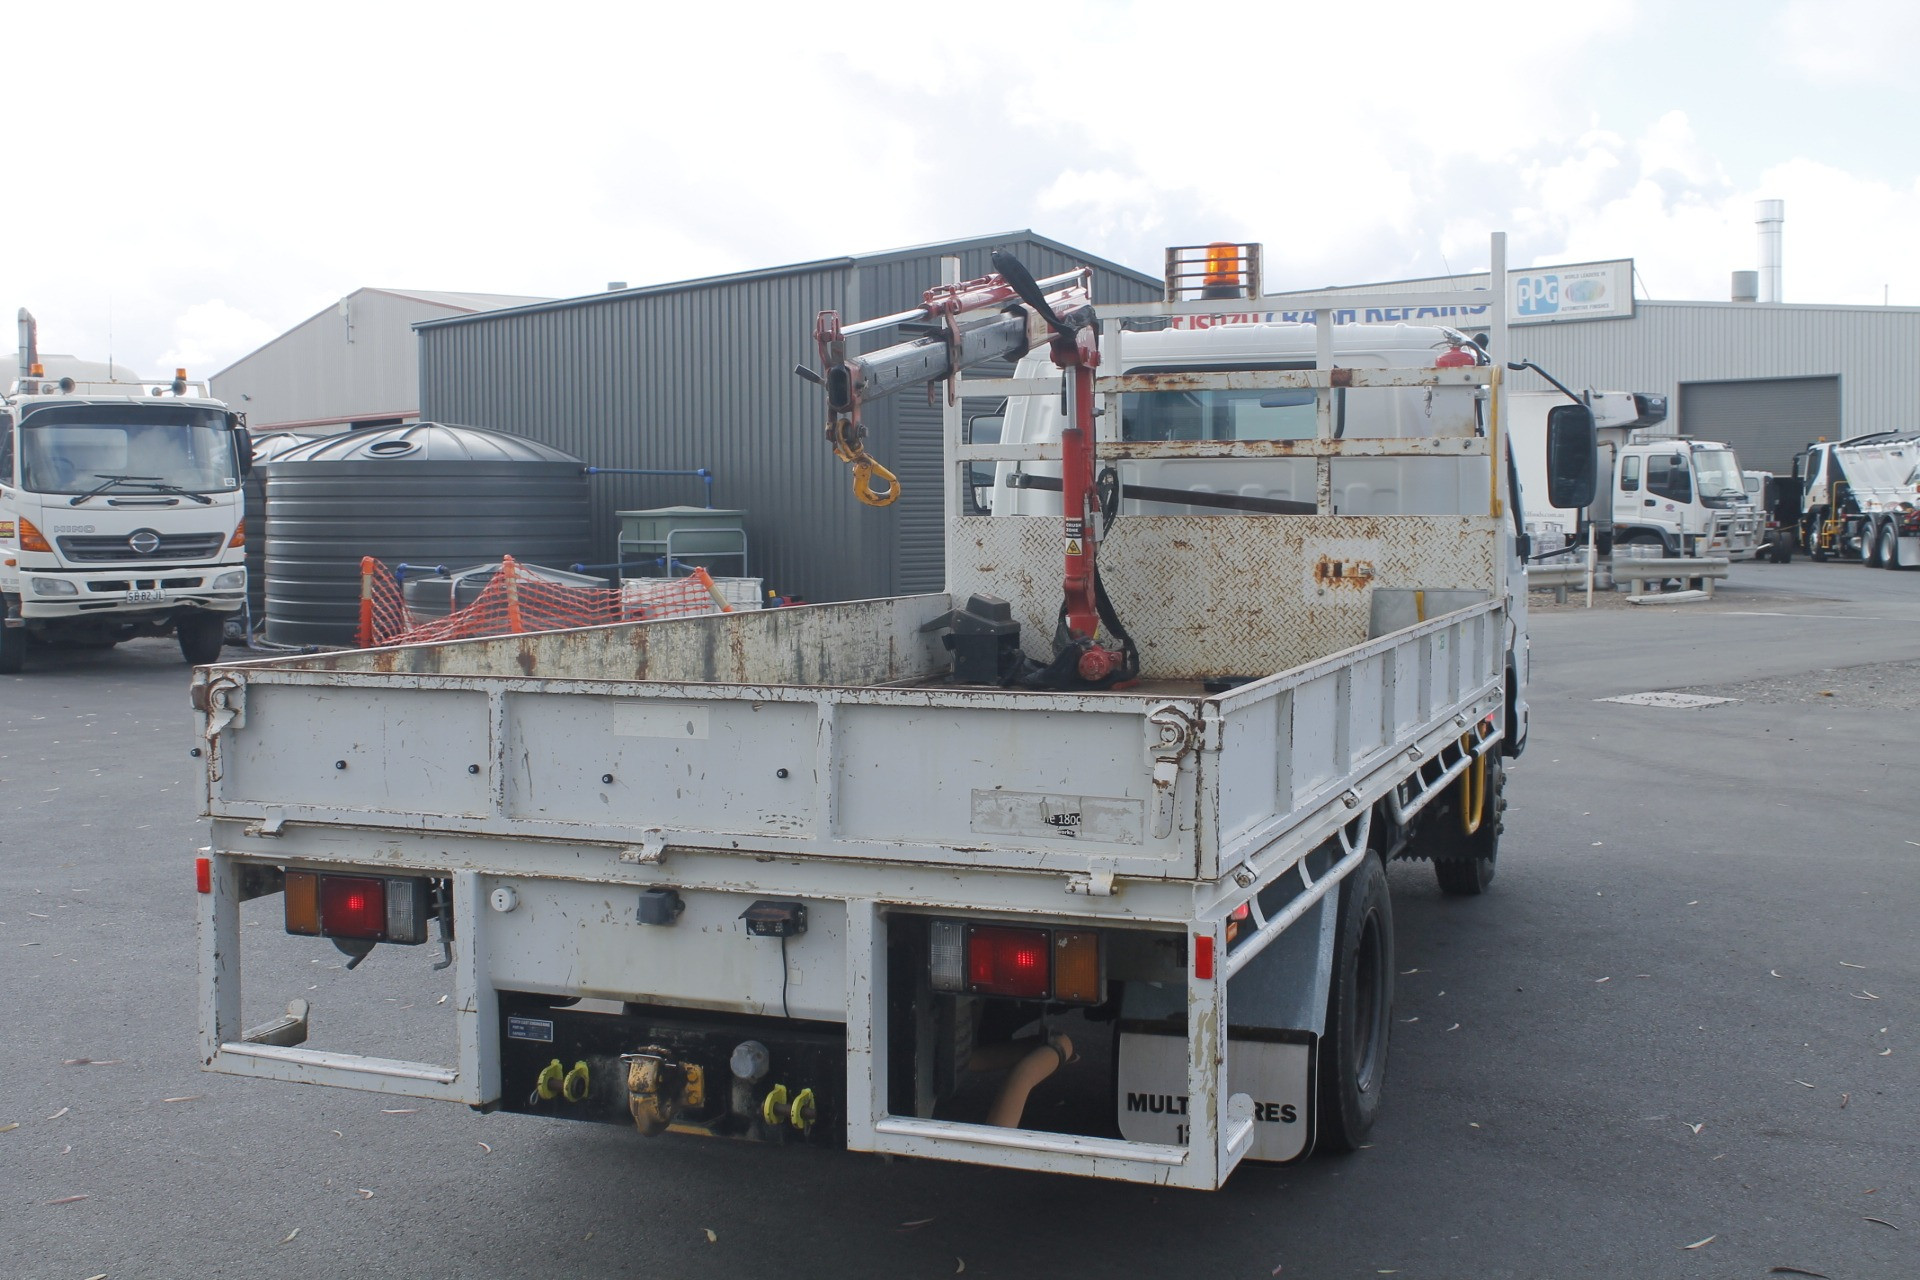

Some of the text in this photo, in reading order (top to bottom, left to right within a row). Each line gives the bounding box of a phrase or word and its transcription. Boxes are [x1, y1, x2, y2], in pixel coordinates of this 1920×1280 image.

[1518, 276, 1558, 311] PPG
[1265, 309, 1356, 325] CRAH
[54, 525, 96, 533] HINO
[1127, 1092, 1298, 1124] MULT RES
